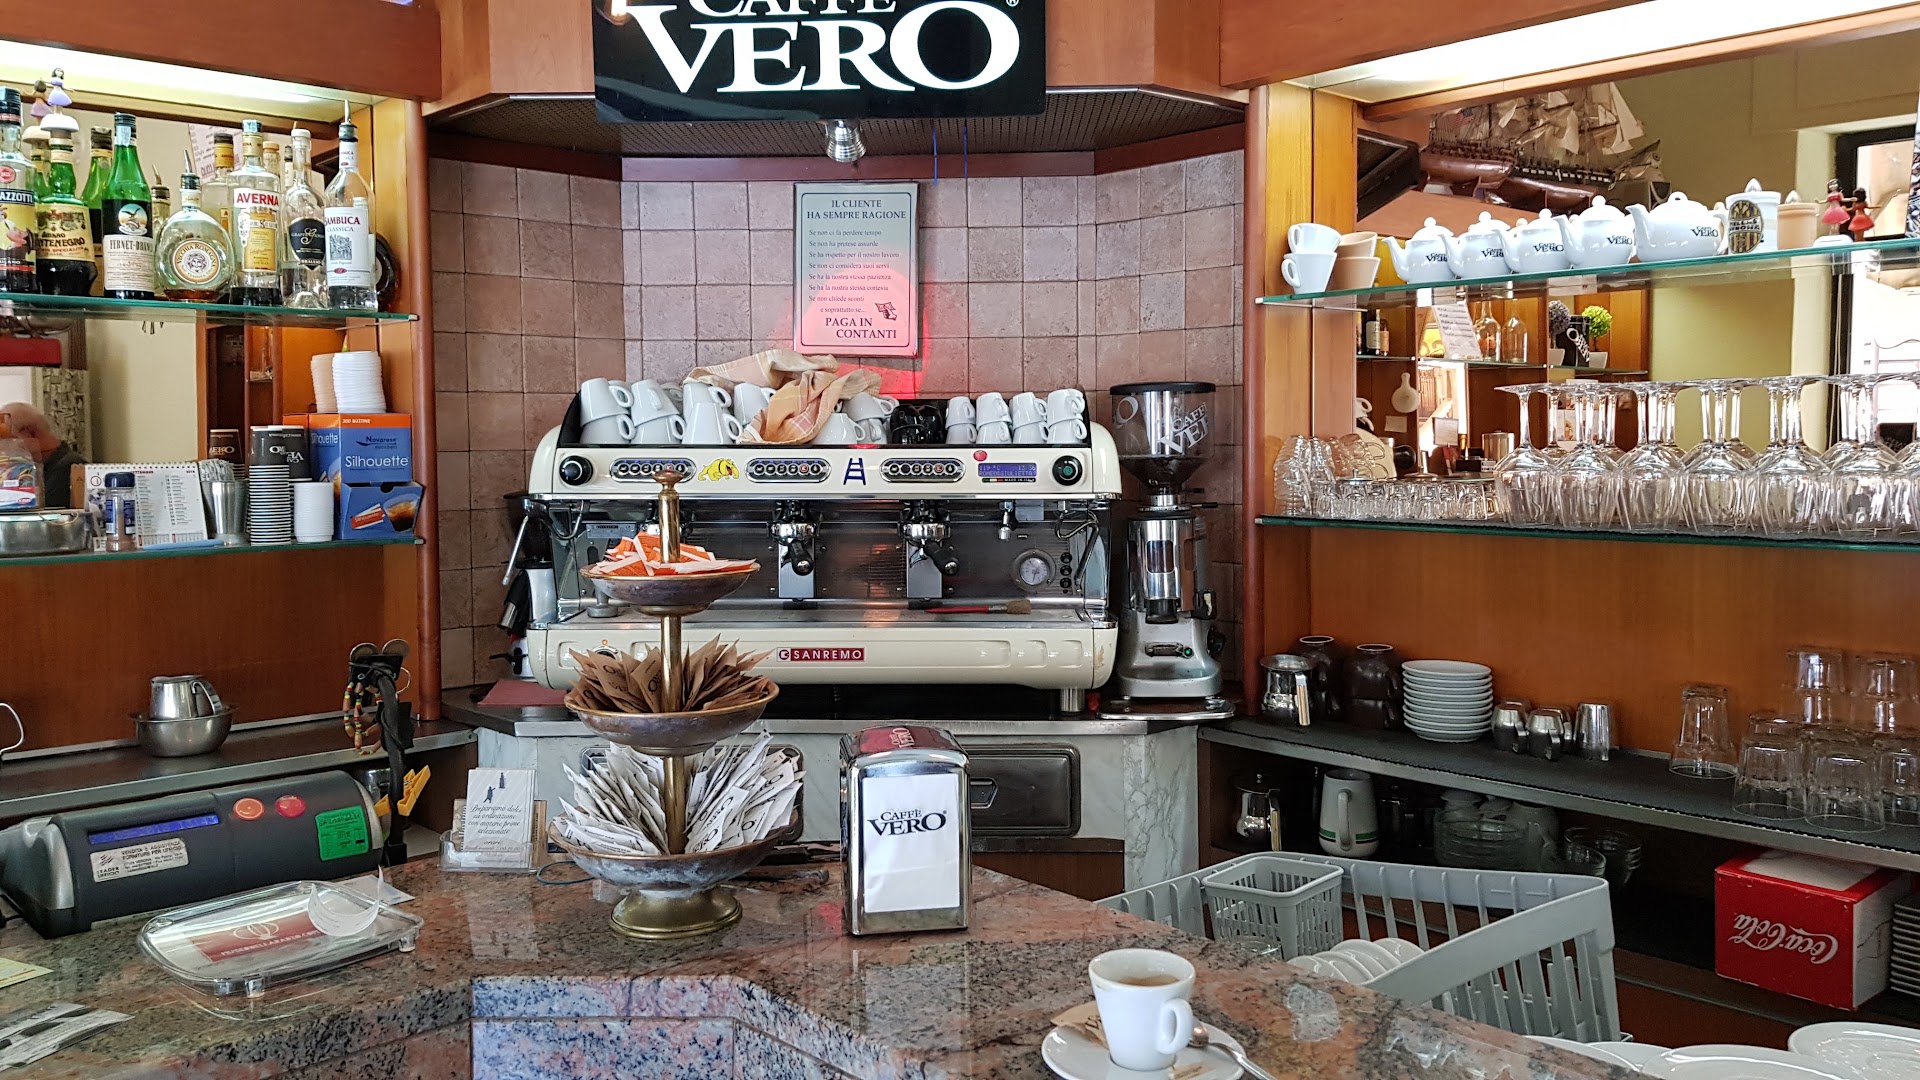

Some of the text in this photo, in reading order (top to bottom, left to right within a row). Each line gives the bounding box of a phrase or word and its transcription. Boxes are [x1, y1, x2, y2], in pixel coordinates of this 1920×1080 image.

[612, 0, 1020, 94] VERO
[236, 192, 279, 206] AVERNA
[831, 199, 882, 208] IL CLIENTE
[807, 211, 907, 219] HA SEMPRE RAGIONE
[1690, 228, 1719, 238] VERO
[1606, 236, 1633, 245] VERO
[1481, 249, 1504, 258] VER
[825, 317, 873, 327] PAGA IN
[836, 329, 897, 339] CONTANTI
[1171, 401, 1207, 432] CAFF
[345, 455, 409, 468] Silhouette
[793, 649, 862, 659] SANREMO
[880, 808, 923, 821] CAFFÈ
[867, 812, 947, 836] VERO
[1727, 913, 1839, 965] Coca-Cola
